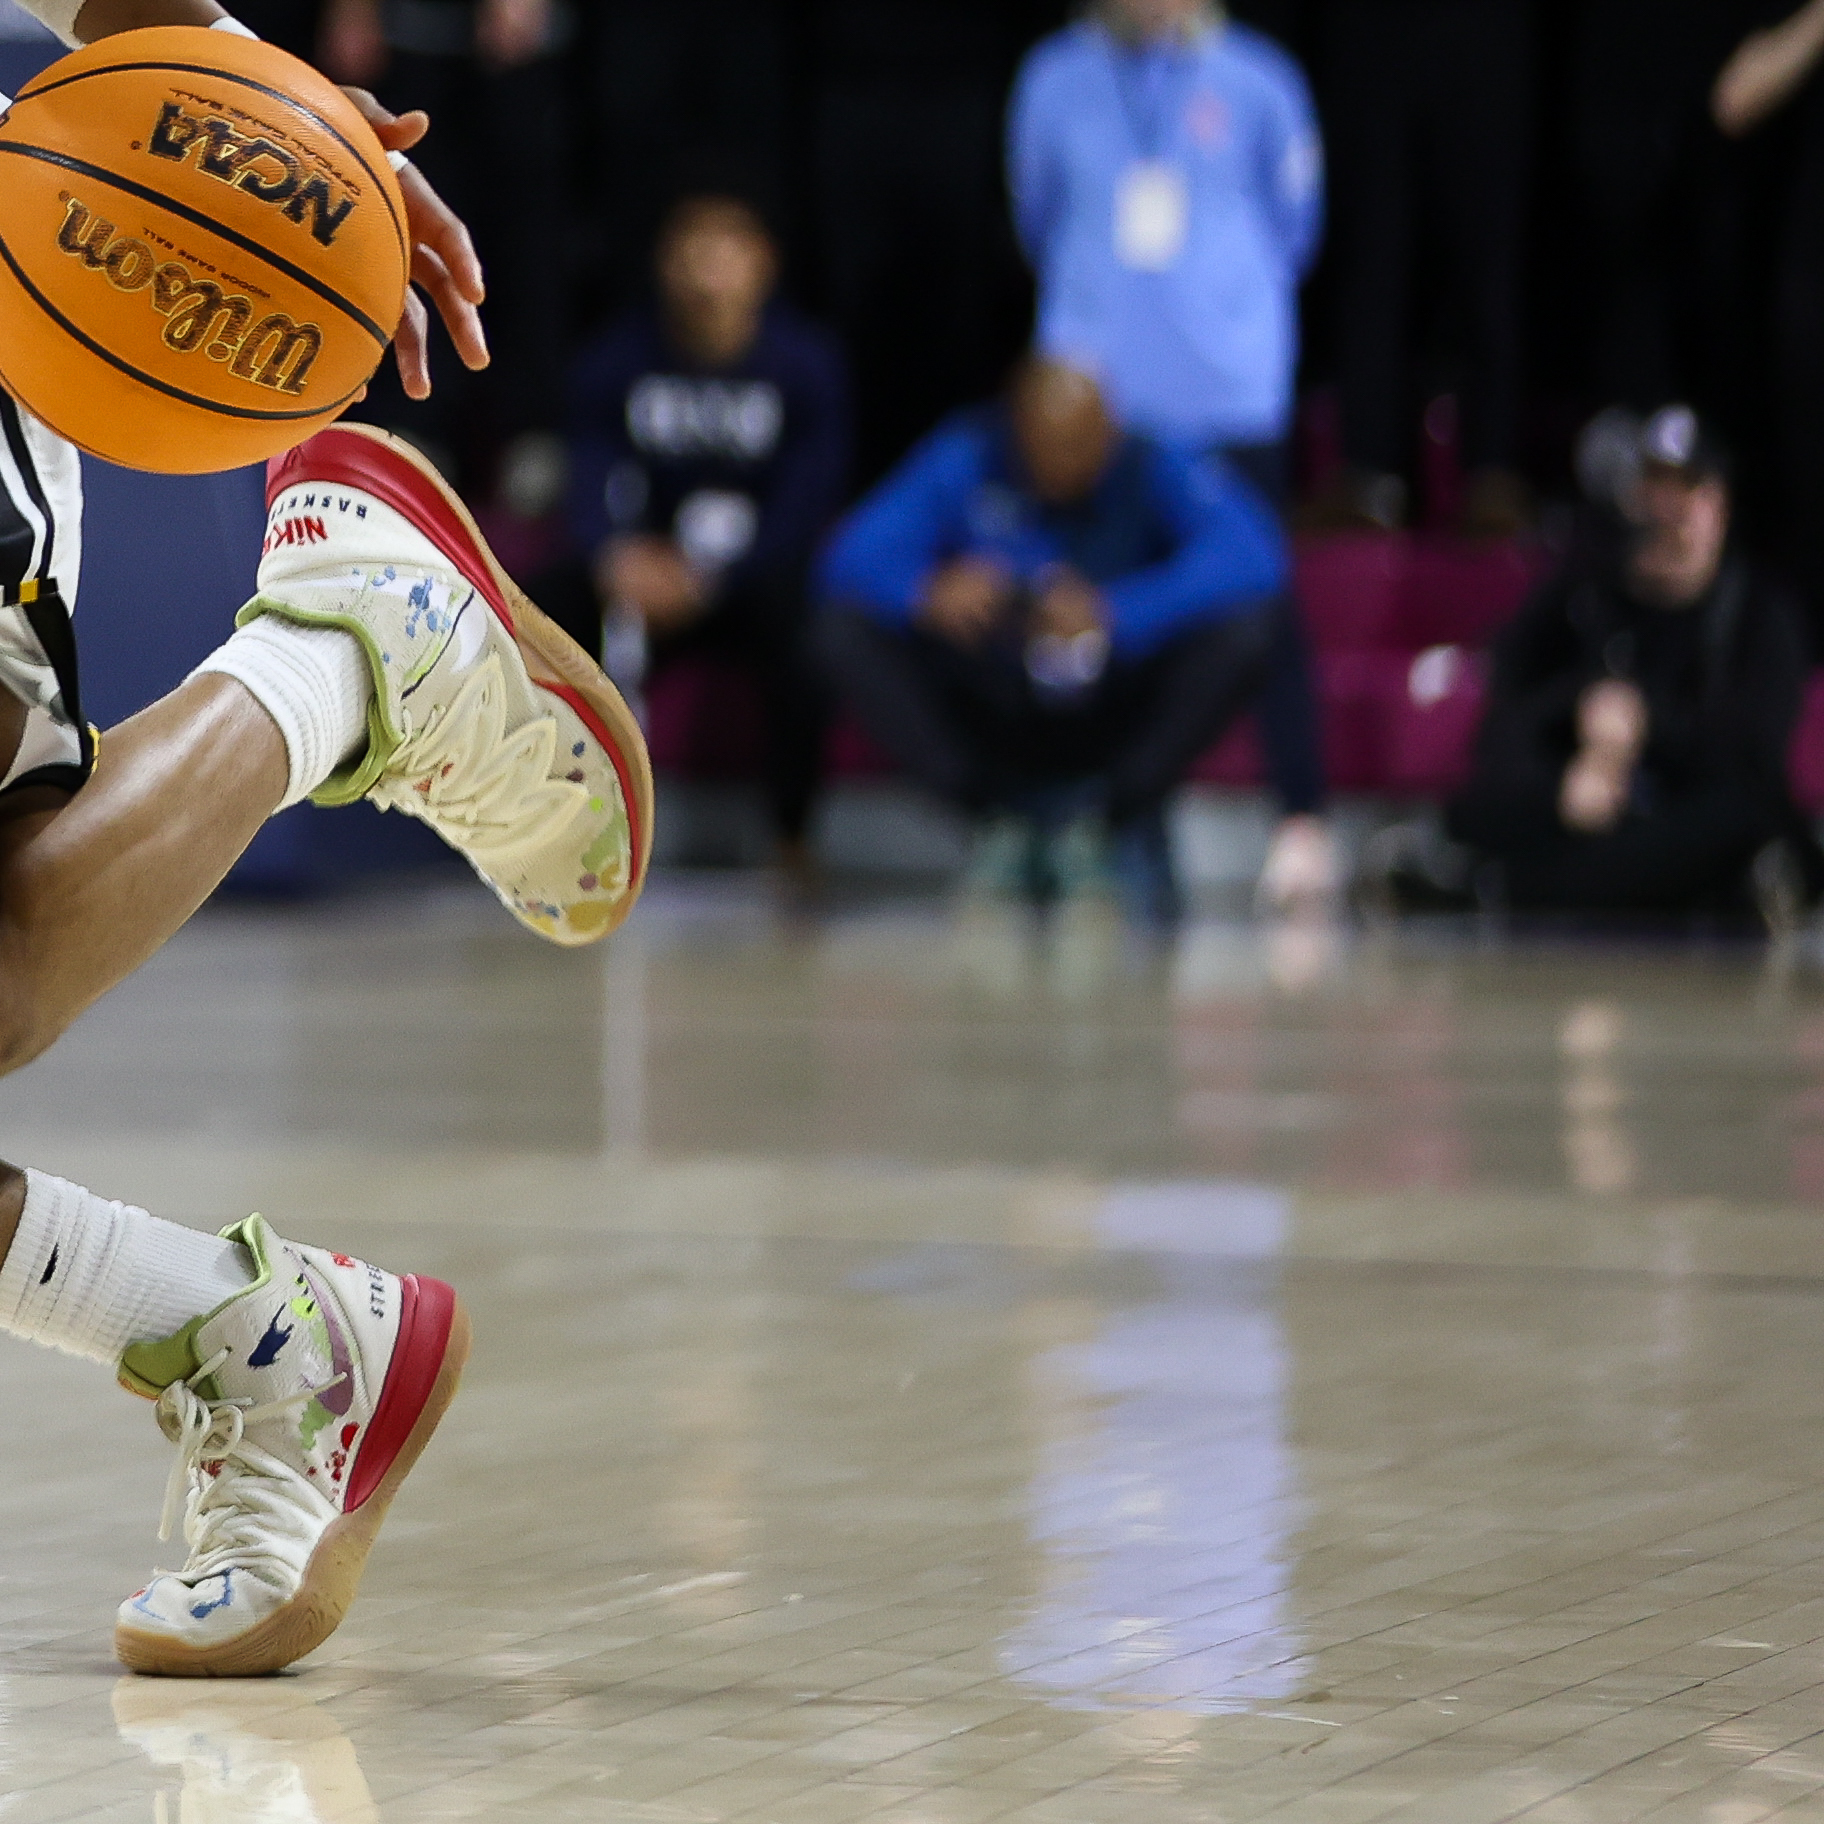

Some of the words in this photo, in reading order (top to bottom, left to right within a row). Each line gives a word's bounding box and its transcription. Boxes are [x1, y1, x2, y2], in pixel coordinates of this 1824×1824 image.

[148, 100, 357, 247] NCAA
[142, 226, 175, 250] BALL
[177, 248, 217, 274] GAME
[56, 197, 324, 396] Wilson
